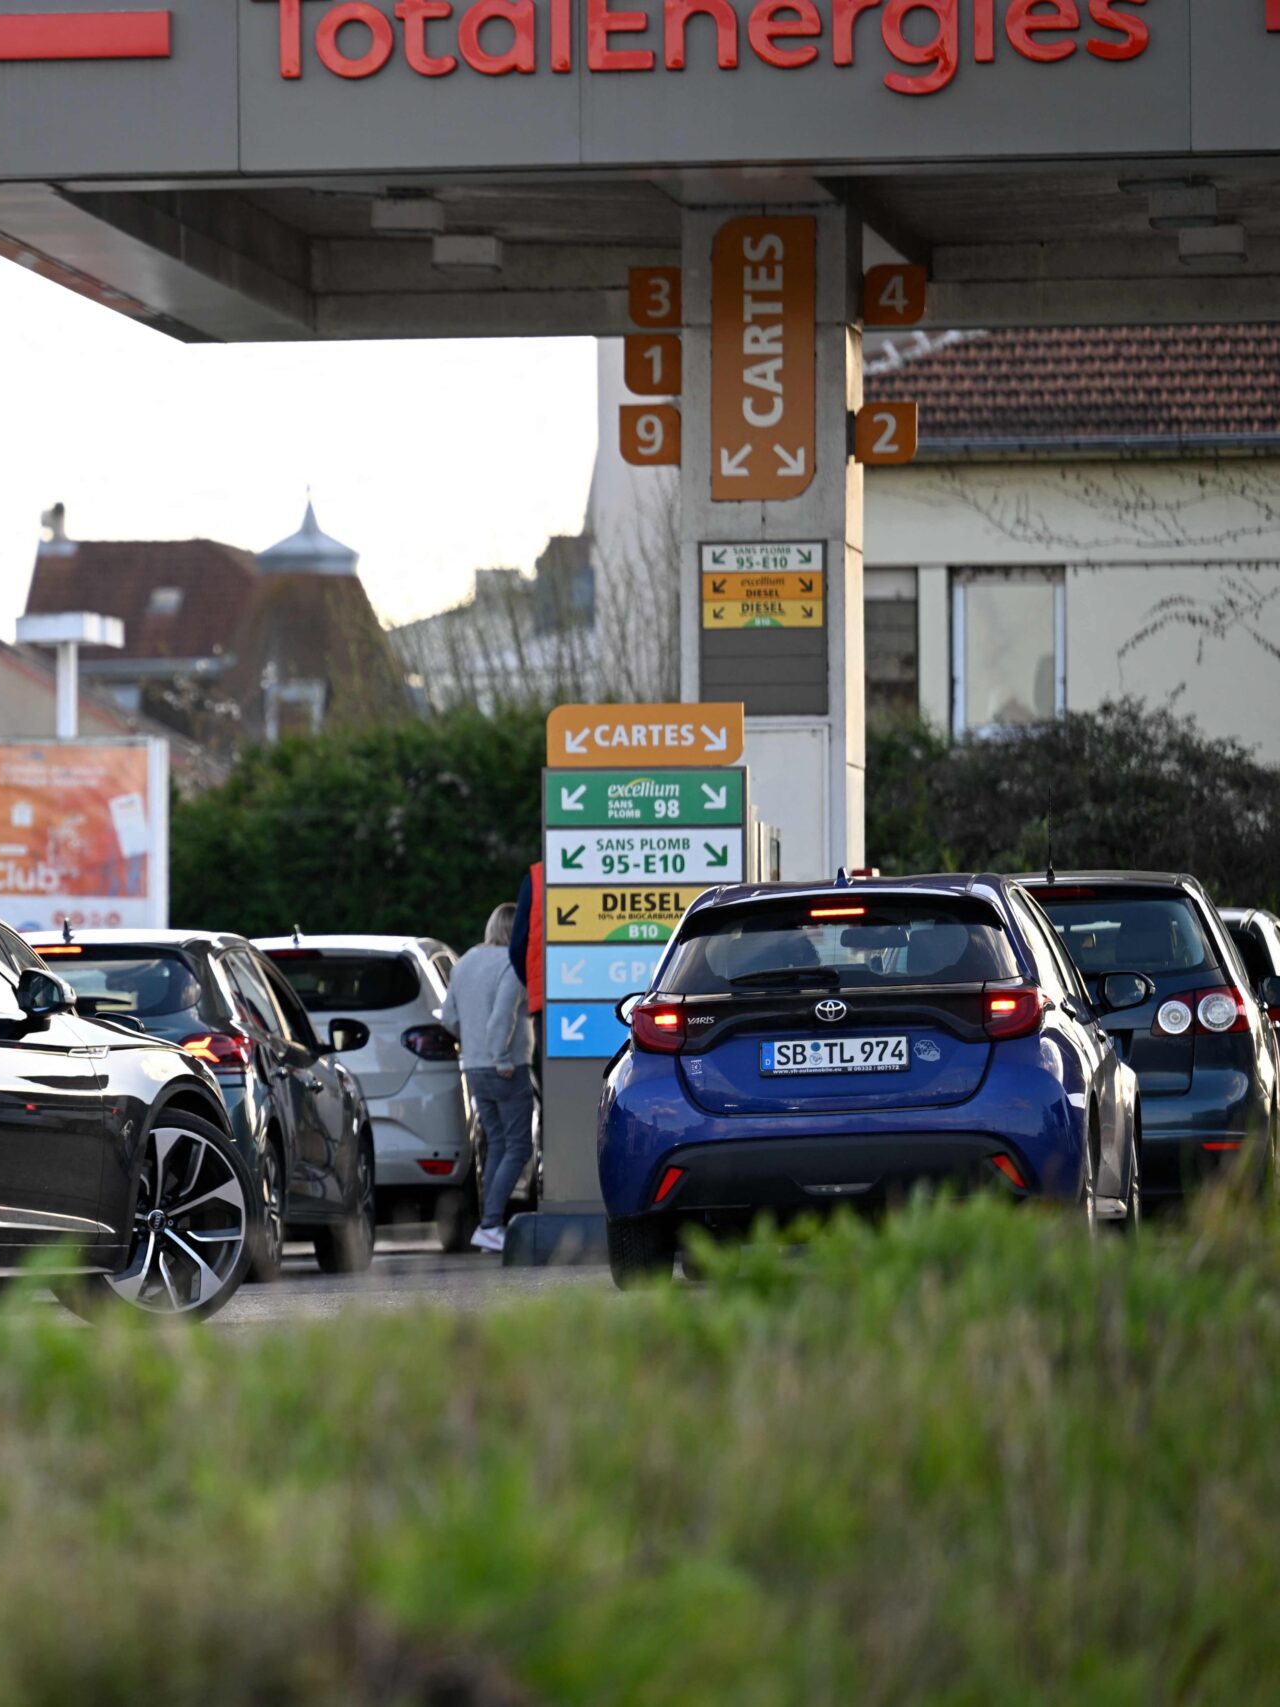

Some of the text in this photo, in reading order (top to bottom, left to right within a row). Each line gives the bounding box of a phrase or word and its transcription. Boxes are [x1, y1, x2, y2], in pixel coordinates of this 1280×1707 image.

[265, 0, 1150, 95] TotalEnergies
[646, 277, 671, 318] 3
[877, 275, 909, 315] 4
[742, 233, 785, 428] CARTES
[643, 344, 662, 385] 1
[635, 414, 664, 456] 9
[871, 412, 899, 454] 2
[732, 544, 791, 555] SANS PLOMB
[736, 556, 788, 569] 95-E10
[746, 588, 780, 599] DIESEL
[741, 601, 783, 613] DIESEL
[593, 724, 695, 747] CARTES
[608, 780, 680, 798] excellium
[608, 799, 633, 809] SANS
[608, 809, 641, 818] PLOMB
[653, 799, 680, 818] 98
[596, 837, 690, 852] SANS PLOMB
[601, 854, 685, 875] 95-E10
[601, 892, 685, 912] DIESEL
[598, 912, 614, 920] 10%
[628, 924, 658, 939] B10
[687, 1016, 715, 1025] YARIS
[776, 1040, 904, 1066] SB TL 974
